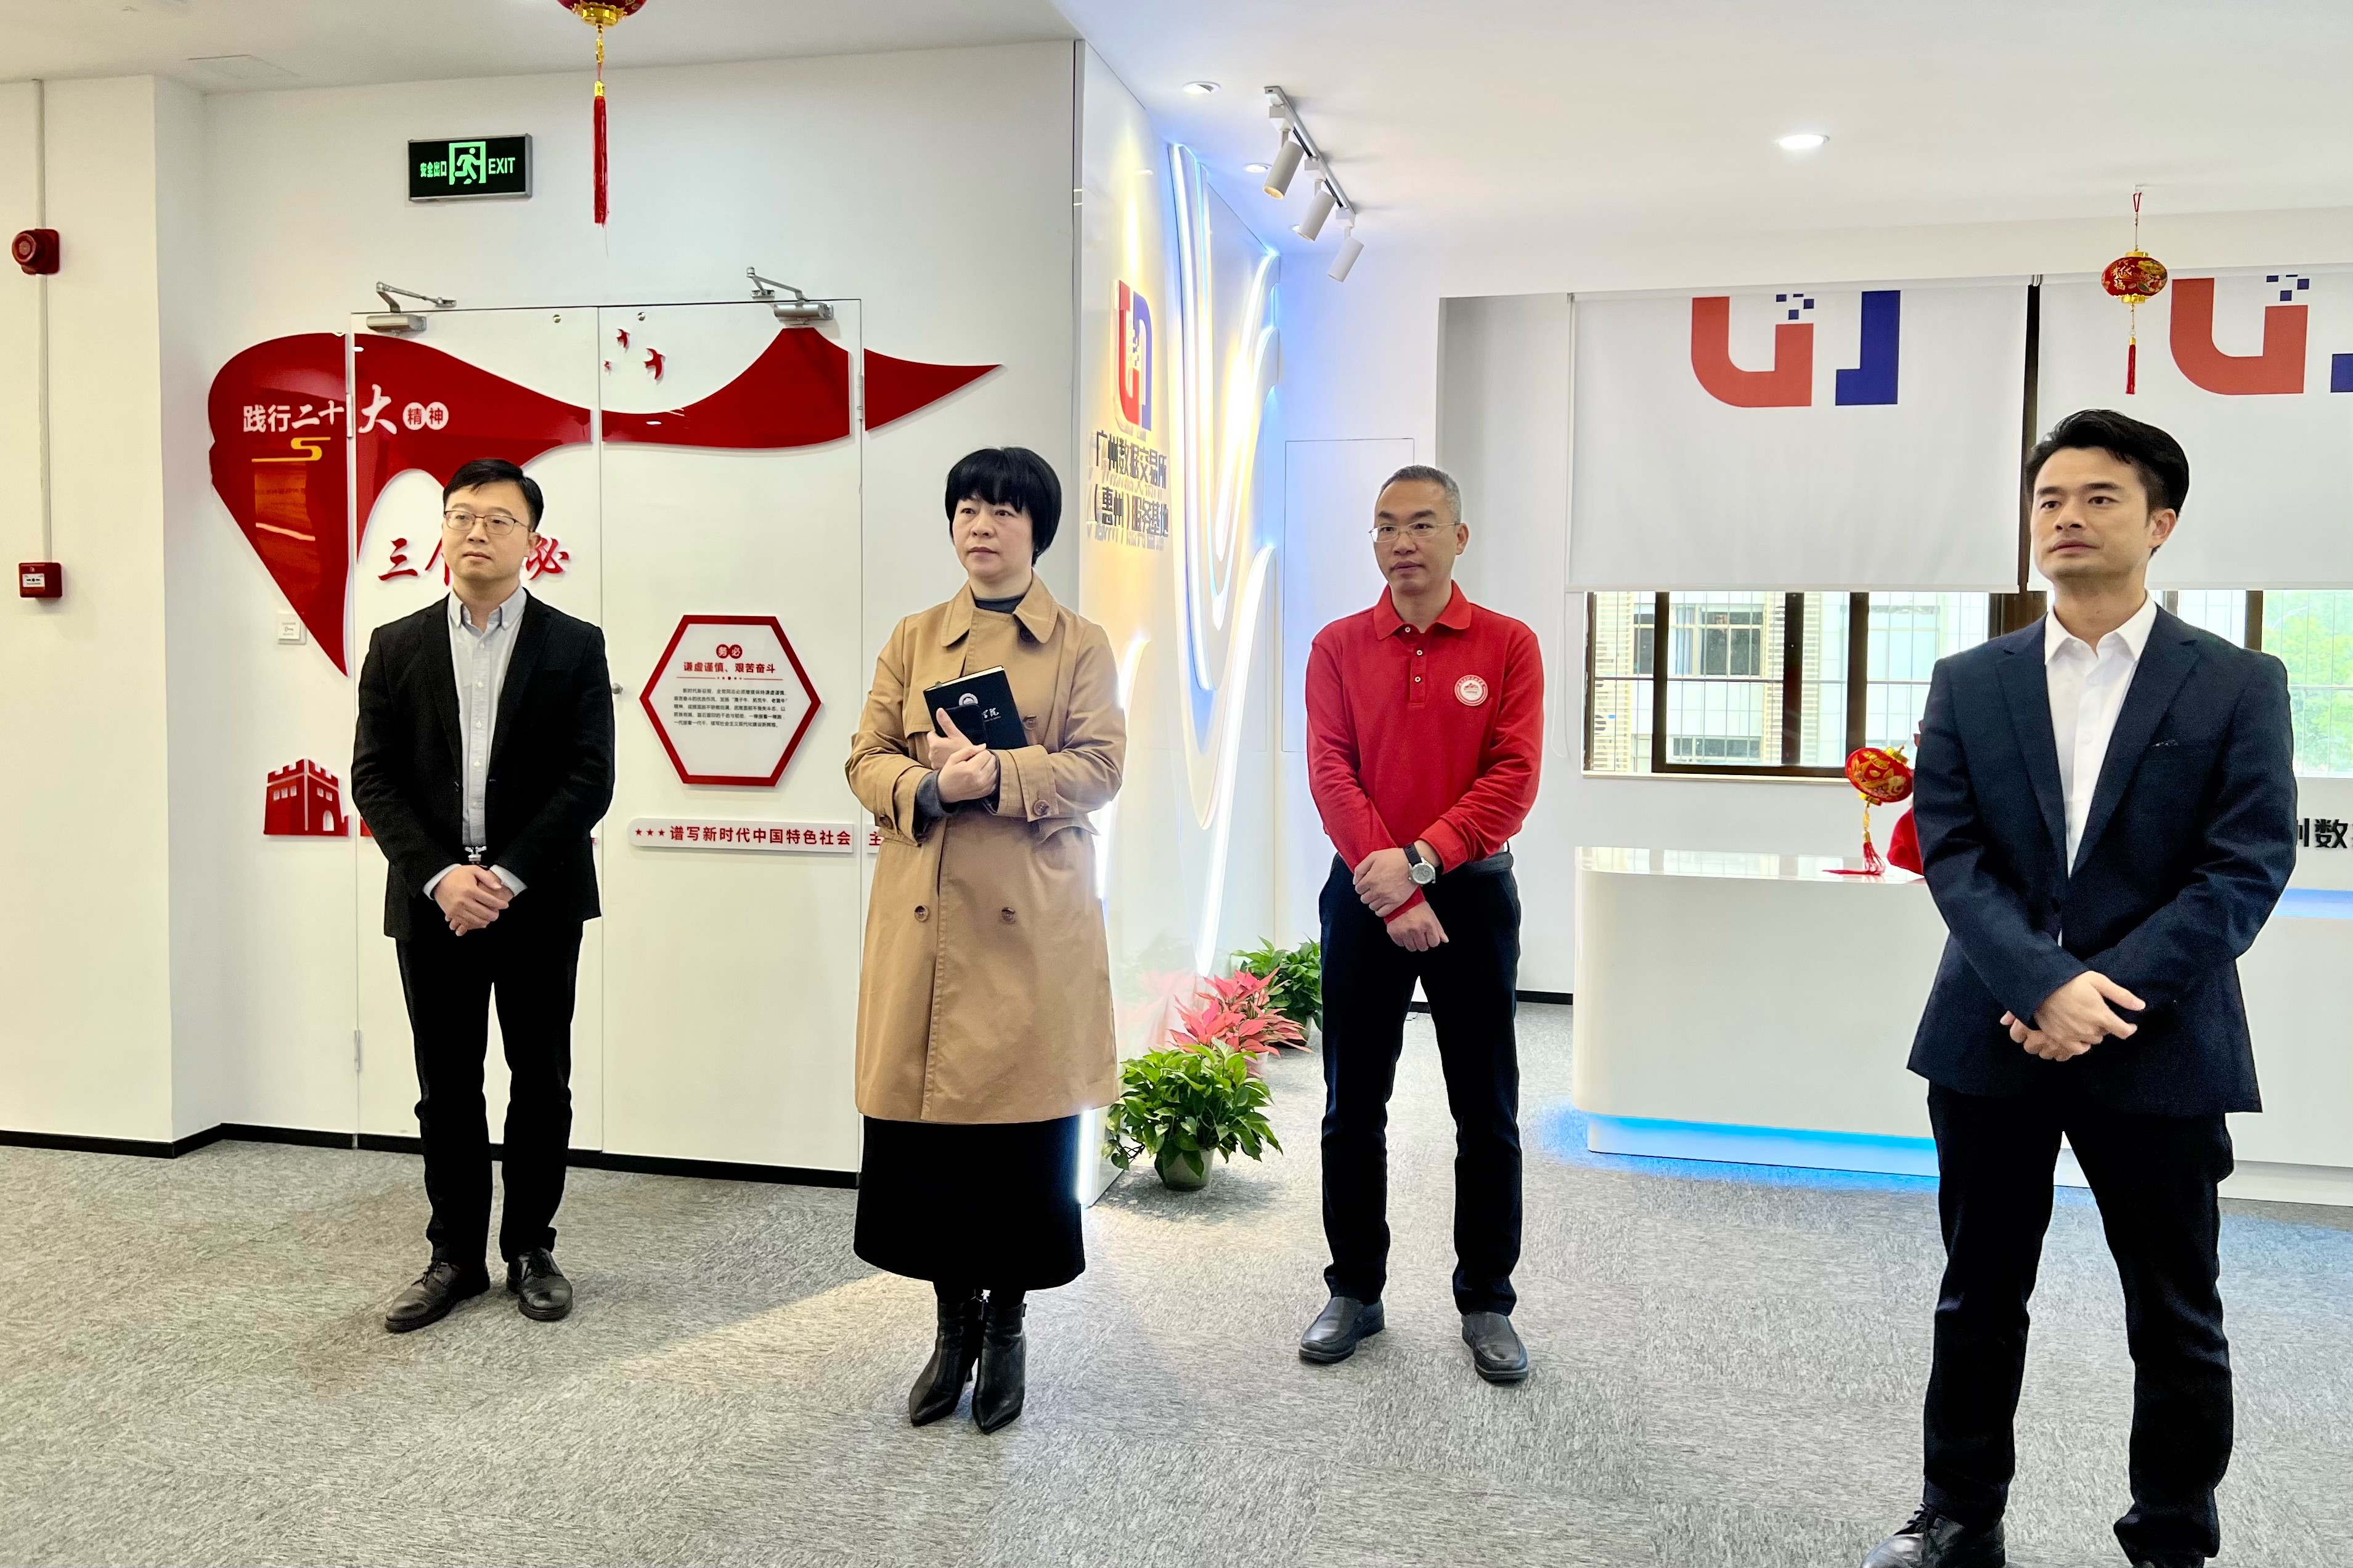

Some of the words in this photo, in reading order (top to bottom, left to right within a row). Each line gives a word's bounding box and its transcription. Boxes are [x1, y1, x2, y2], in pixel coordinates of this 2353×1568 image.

[420, 161, 447, 177] 安全出口
[489, 157, 515, 174] EXIT
[1096, 429, 1167, 489] 广州数据交易所
